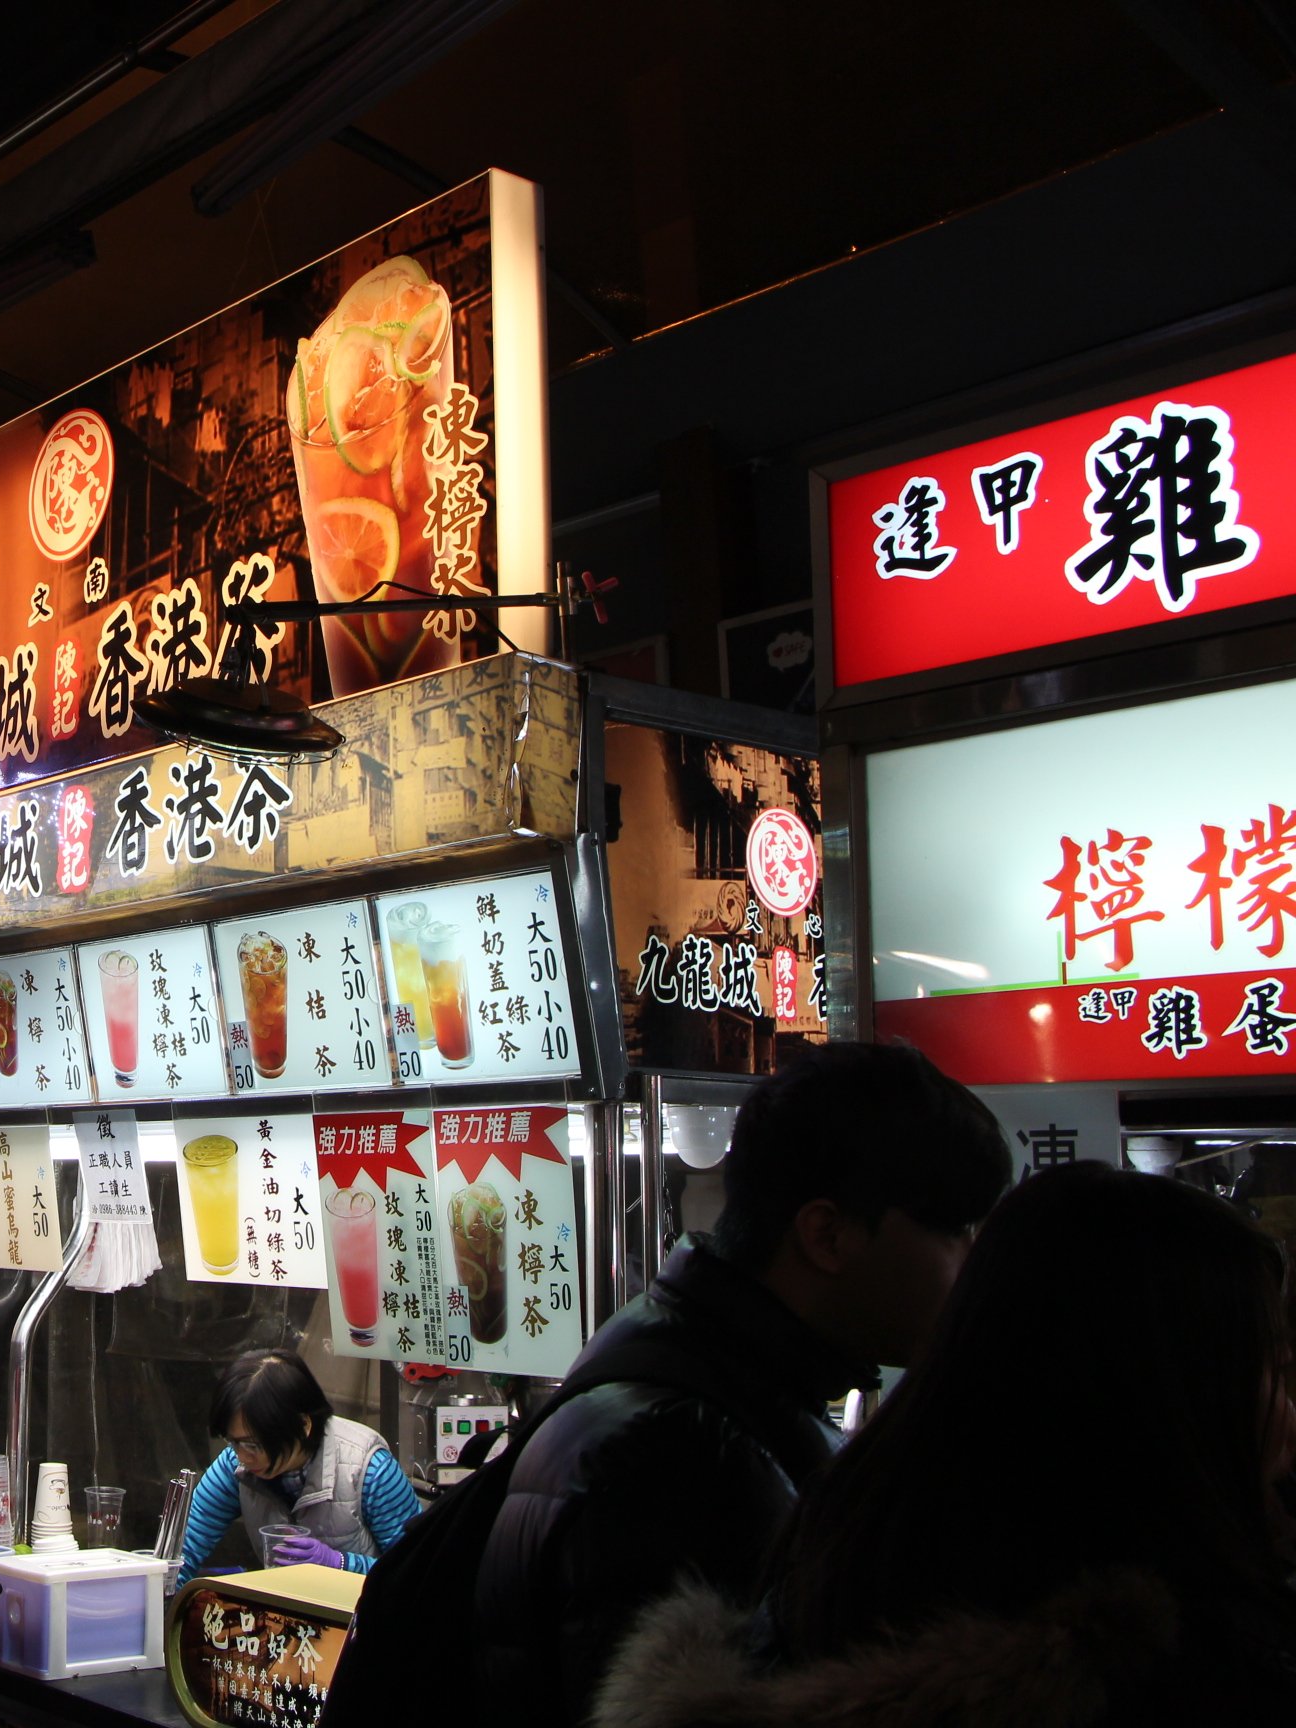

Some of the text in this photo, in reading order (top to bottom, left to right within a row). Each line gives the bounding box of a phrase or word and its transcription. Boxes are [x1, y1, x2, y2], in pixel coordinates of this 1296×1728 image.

[422, 383, 491, 644] 凍檸茶
[49, 638, 81, 738] 陳記
[89, 551, 286, 738] 香港茶
[59, 786, 92, 893] 陳記
[106, 754, 294, 877] 香港茶
[533, 883, 551, 904] 冷
[1043, 802, 1296, 973] 檸檬
[296, 931, 338, 1078] 凍桔茶
[636, 933, 764, 1018] 九龍城
[775, 948, 796, 1018] 陳記
[20, 969, 51, 1092] 凍檸茶
[229, 1023, 255, 1089] 熱 50
[394, 1007, 422, 1078] 熱 50
[88, 1150, 134, 1171] 正職人員
[97, 1113, 116, 1140] 徵
[318, 1123, 398, 1156] 強力推薦
[438, 1111, 532, 1145] 強力推薦
[98, 1180, 133, 1198] 工讀生
[255, 1119, 289, 1281] 黃金油切綠茶
[514, 1188, 550, 1339] 凍檸茶
[555, 1221, 572, 1243] 冷
[447, 1289, 472, 1364] 熱 50
[202, 1602, 324, 1674] 絕品好茶
